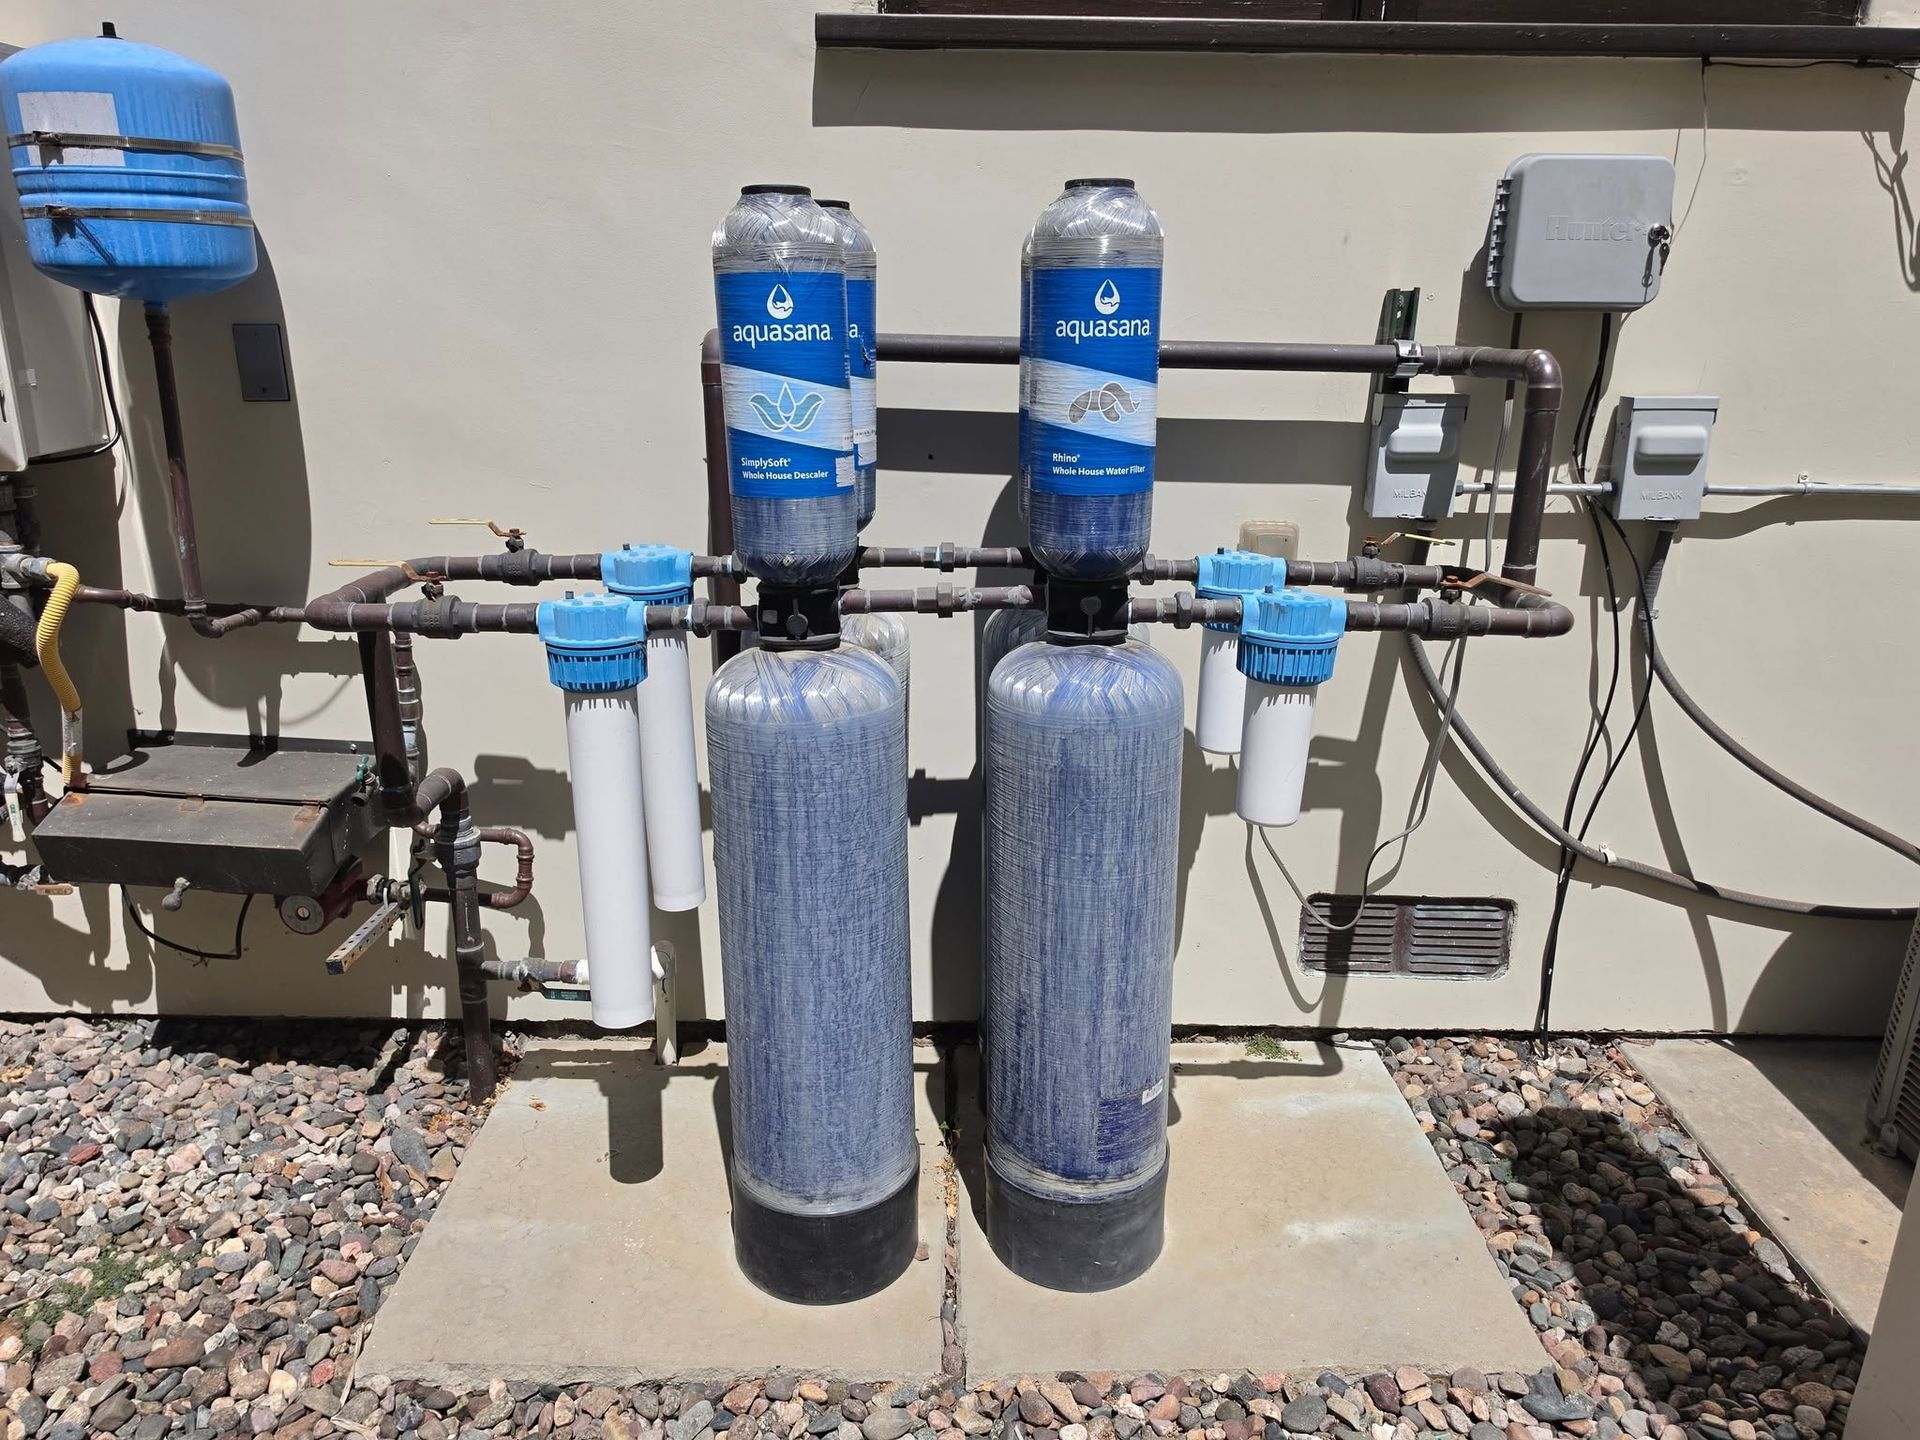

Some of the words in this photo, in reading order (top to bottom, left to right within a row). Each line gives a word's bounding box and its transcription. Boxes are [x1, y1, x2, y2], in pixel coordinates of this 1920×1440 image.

[1545, 214, 1639, 242] Hunter
[733, 322, 831, 349] aquasana
[1056, 318, 1150, 344] aquasana
[741, 457, 788, 470] SimplySoft
[1052, 453, 1078, 463] Rhino
[742, 470, 765, 480] Whole
[765, 471, 793, 480] House
[794, 469, 829, 480] Descaler
[1052, 466, 1077, 475] Whole
[1078, 467, 1105, 476] House
[1105, 467, 1129, 475] Water
[1129, 464, 1146, 474] Filter
